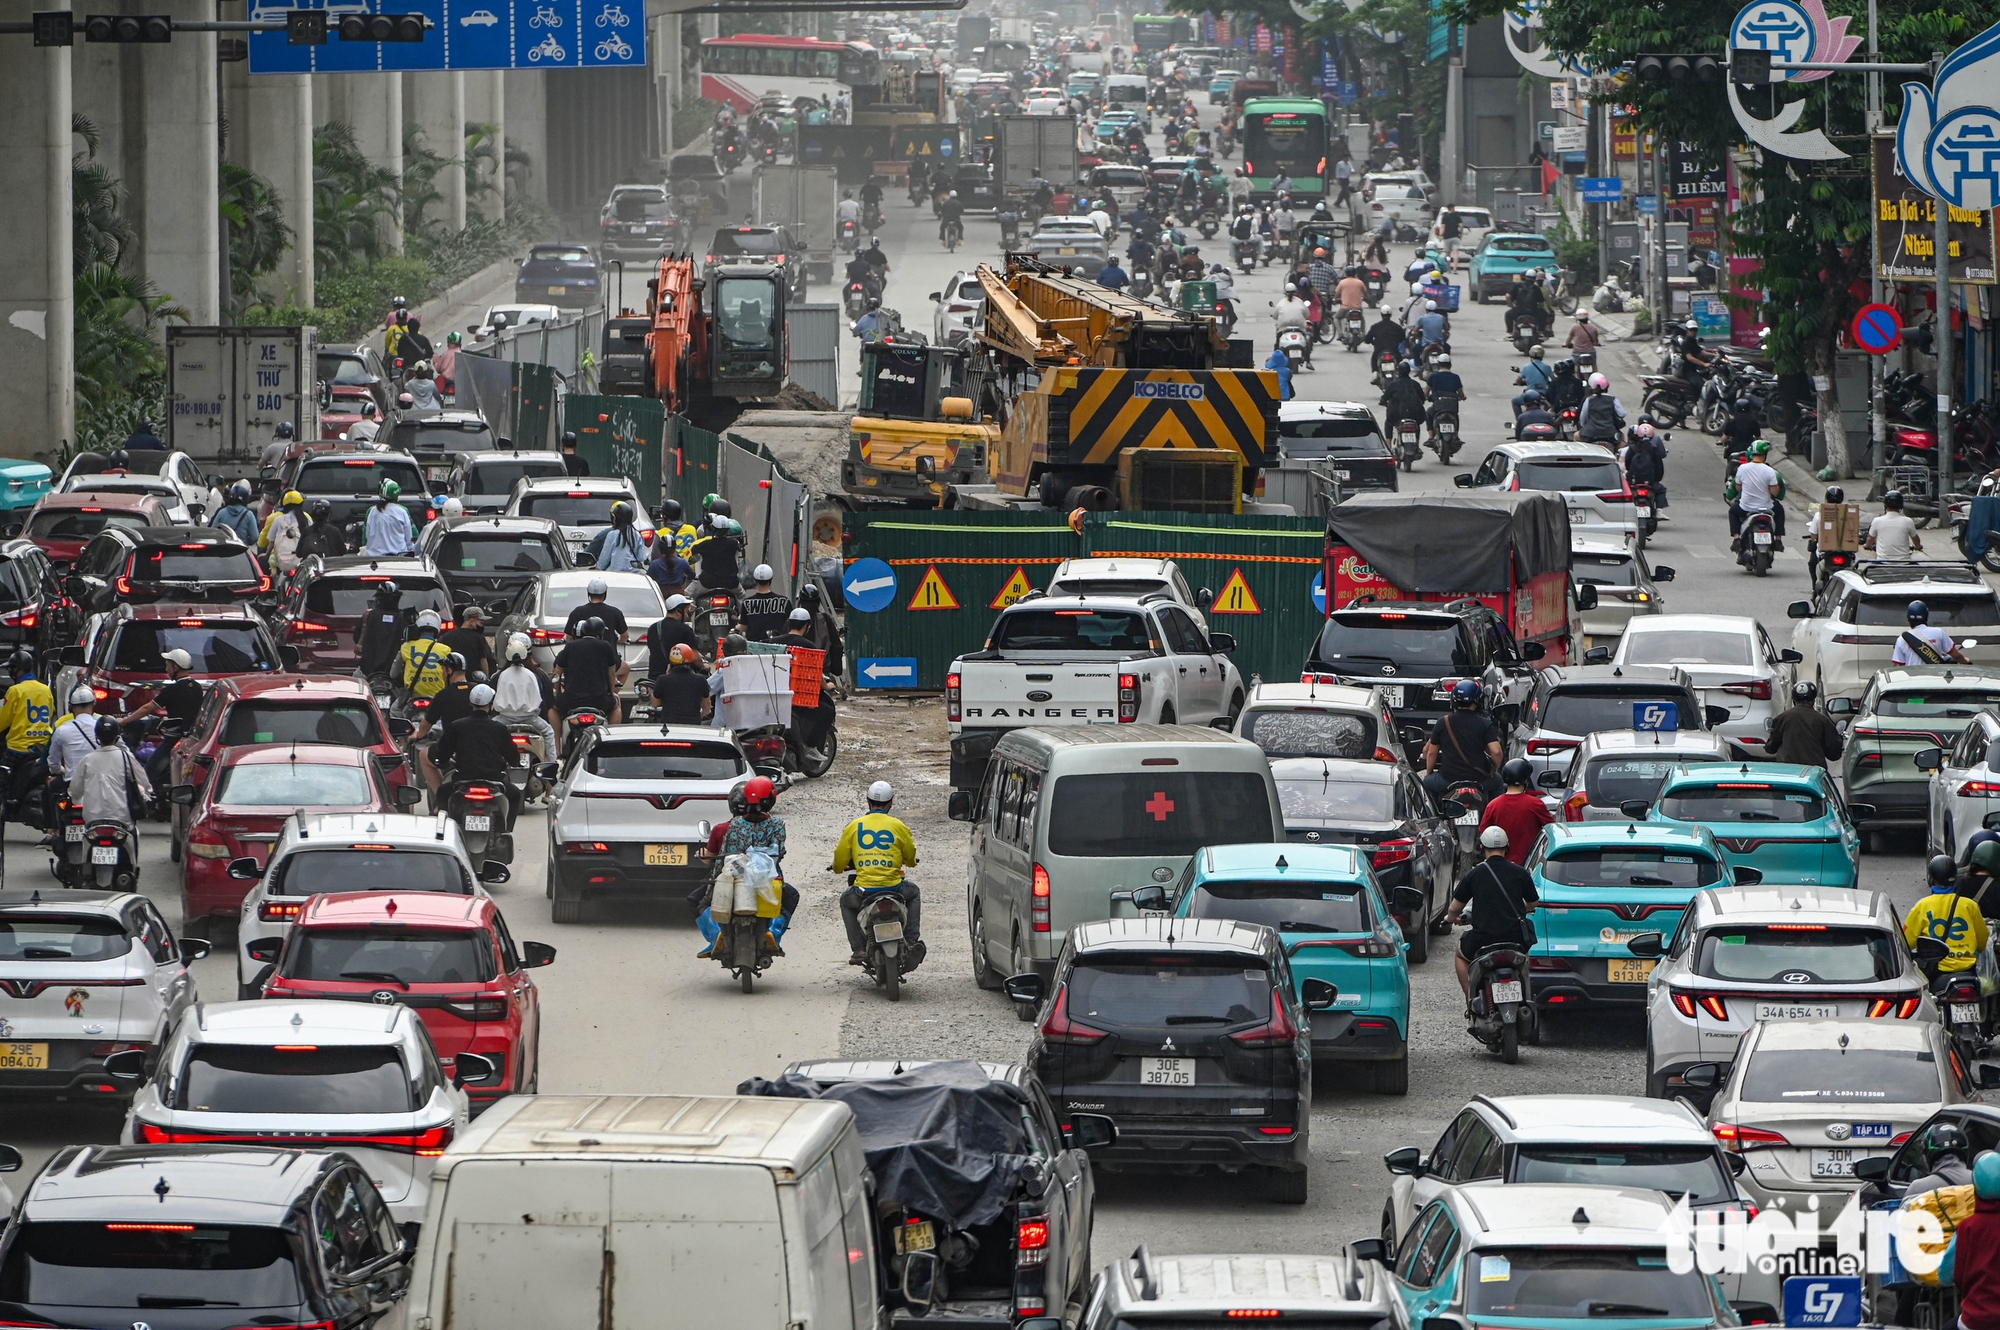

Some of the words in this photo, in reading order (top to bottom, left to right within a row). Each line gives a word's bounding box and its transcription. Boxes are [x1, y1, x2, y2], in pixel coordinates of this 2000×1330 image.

[1677, 174, 1727, 194] HIỂM
[1880, 199, 1898, 221] Bia
[1904, 234, 1934, 261] Nhậu
[261, 344, 277, 360] XE
[257, 369, 281, 387] THƯ
[1135, 382, 1203, 400] KOBELCO
[257, 394, 282, 410] BÁO
[175, 402, 221, 415] 29C-890.99
[1013, 584, 1021, 594] ĐI
[1380, 686, 1397, 696] 30E
[27, 698, 51, 724] be
[966, 708, 1114, 718] RANGER
[1643, 705, 1666, 727] G7
[1625, 763, 1640, 772] 32
[1641, 763, 1657, 771] 32
[858, 822, 895, 850] be
[657, 845, 675, 854] 29K
[649, 855, 683, 864] 019.57
[1926, 910, 1969, 941] be
[1622, 960, 1643, 970] 29H
[1496, 992, 1520, 1001] 135.97
[10, 1044, 33, 1056] 29E
[1, 1056, 42, 1068] 084.07
[1157, 1059, 1180, 1071] 30E
[1147, 1072, 1189, 1084] 387.05
[1066, 1102, 1105, 1110] XPANDER
[1856, 1124, 1872, 1137] TẬP
[1874, 1124, 1888, 1135] LÁI
[1827, 1150, 1852, 1161] 30M
[1817, 1163, 1853, 1175] 543.3
[1804, 1283, 1844, 1322] G7
[1802, 1314, 1825, 1323] TAXI
